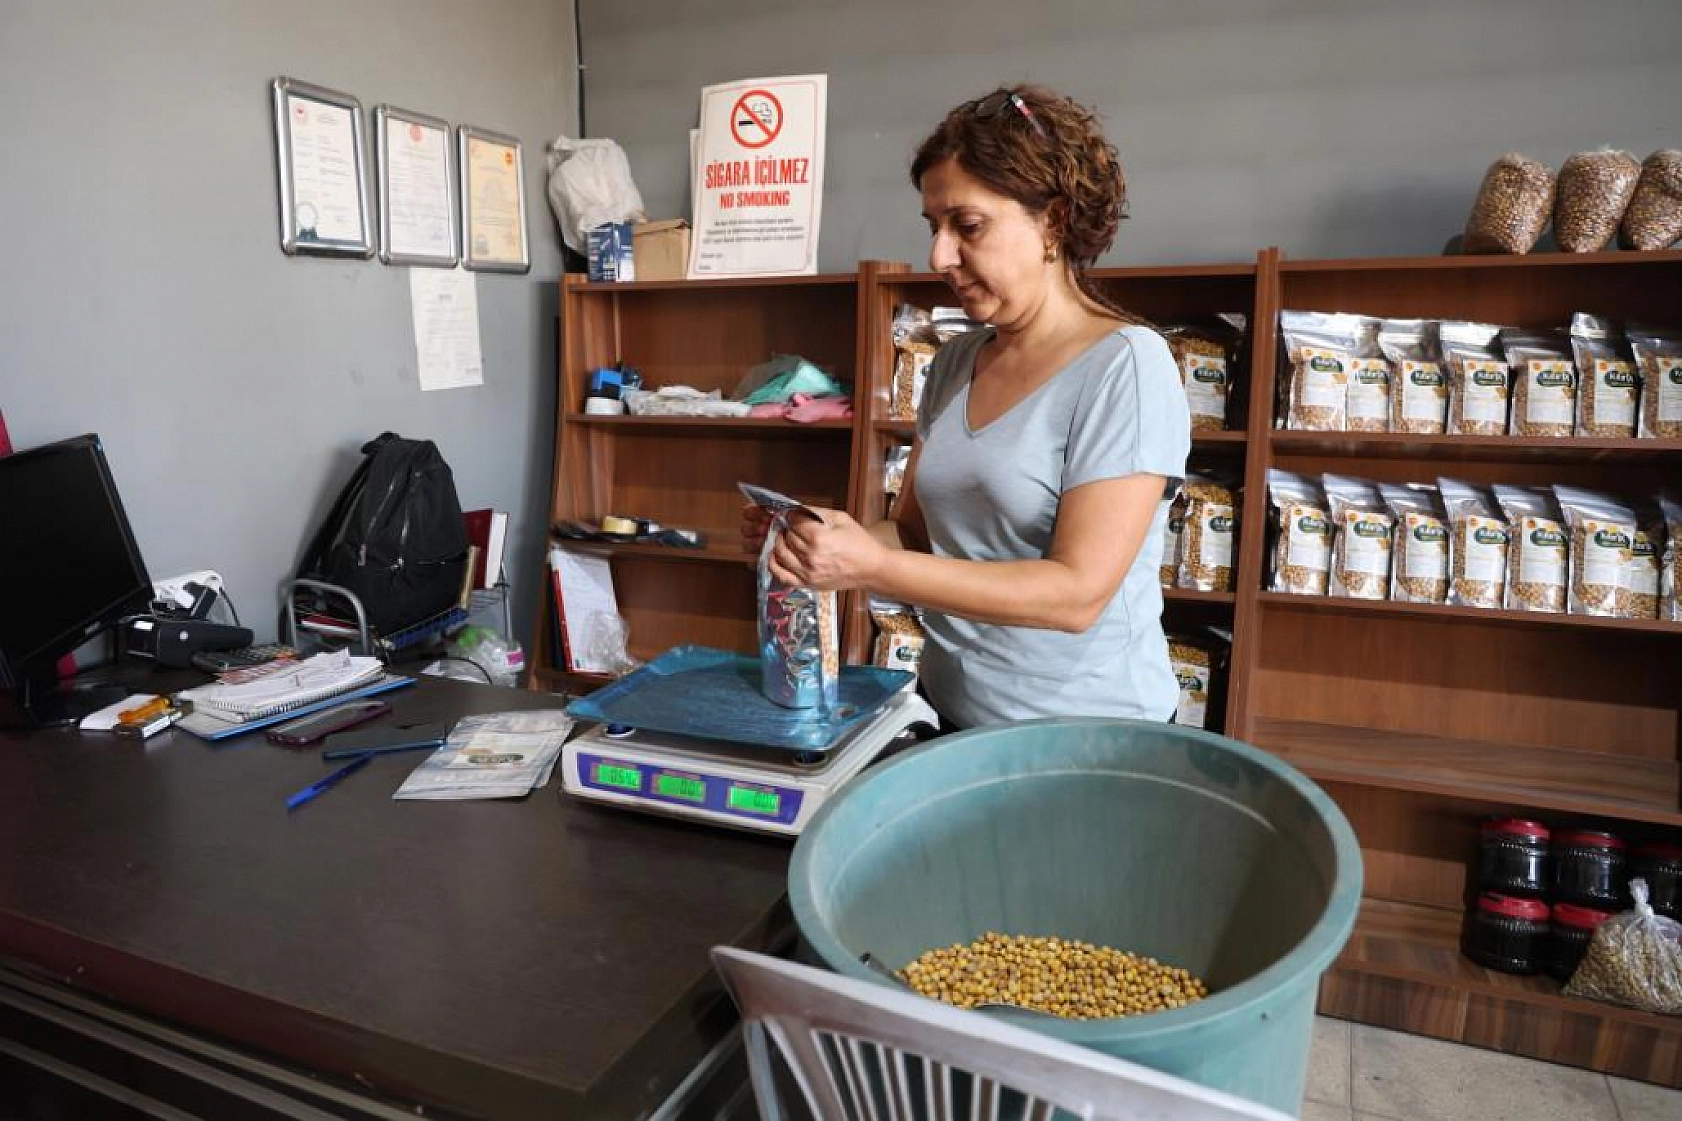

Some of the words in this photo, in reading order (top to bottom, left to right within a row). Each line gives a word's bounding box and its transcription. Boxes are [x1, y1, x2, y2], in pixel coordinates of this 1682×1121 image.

[705, 159, 750, 189] SİGARA
[754, 155, 809, 188] İÇİLMEZ
[720, 192, 735, 209] NO
[737, 190, 790, 208] SMOKING
